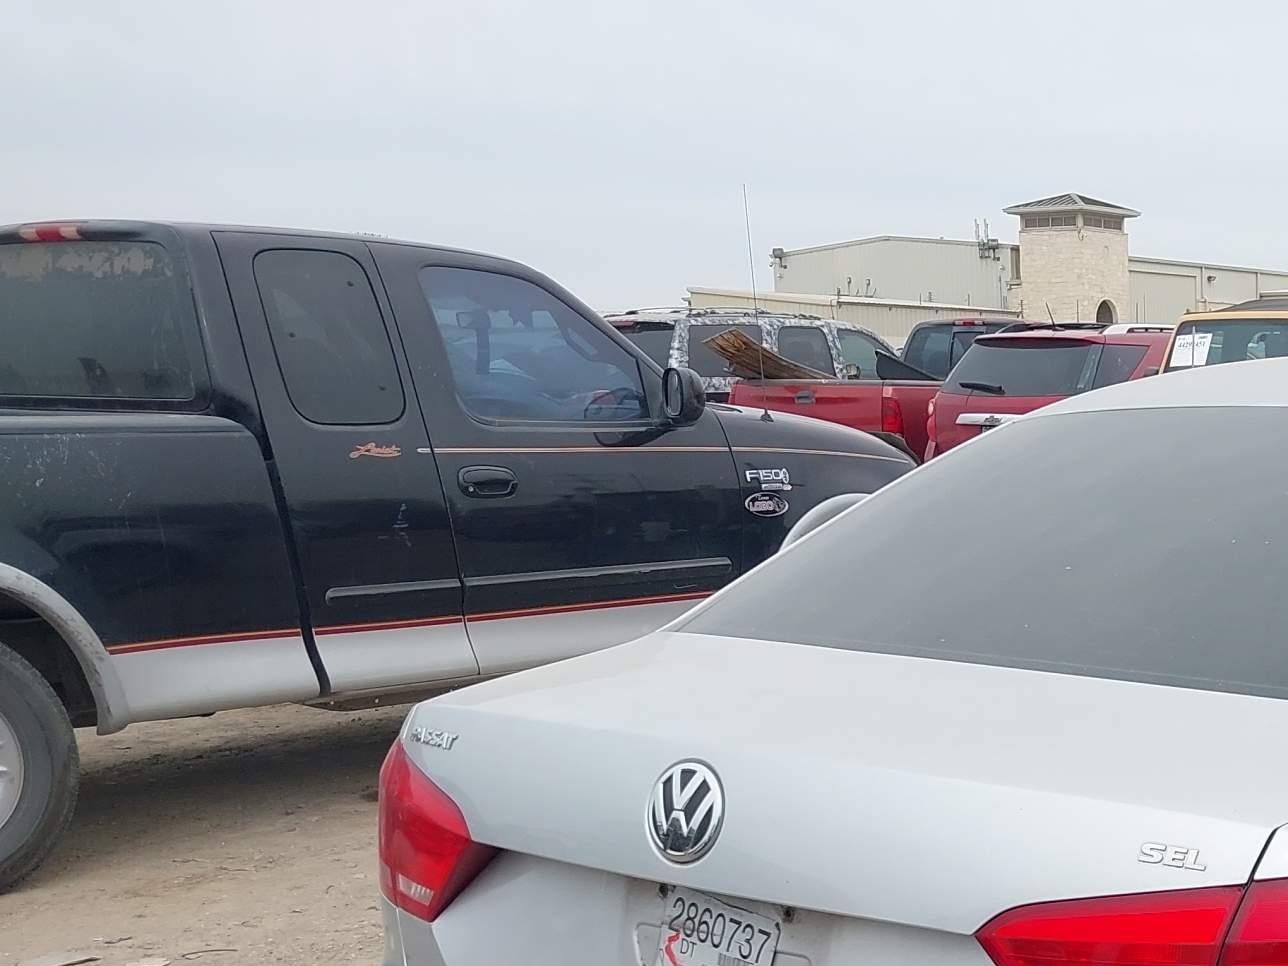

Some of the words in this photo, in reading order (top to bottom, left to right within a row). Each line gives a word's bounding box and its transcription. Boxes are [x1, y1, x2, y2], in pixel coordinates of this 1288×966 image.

[1138, 842, 1206, 872] SEL
[668, 897, 772, 964] 2860737
[680, 938, 697, 958] DT
